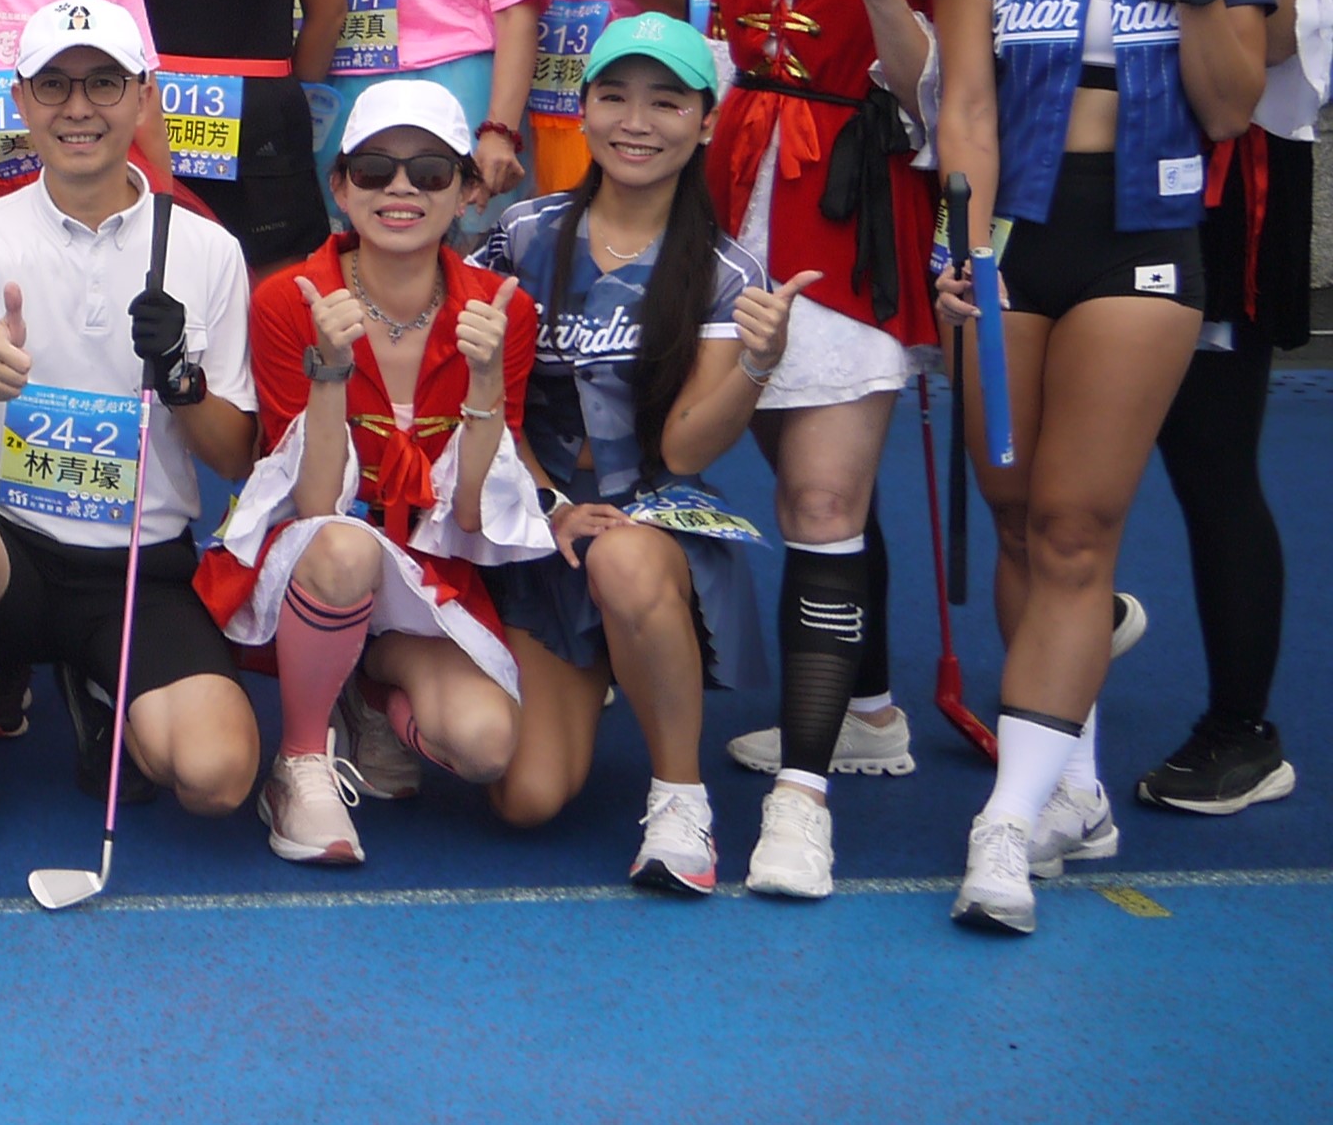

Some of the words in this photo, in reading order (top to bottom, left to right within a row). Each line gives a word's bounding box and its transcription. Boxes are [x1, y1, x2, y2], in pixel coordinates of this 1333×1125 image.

[164, 118, 230, 149] 阮明芳
[25, 411, 120, 457] 24-2
[23, 449, 123, 491] 林青壕
